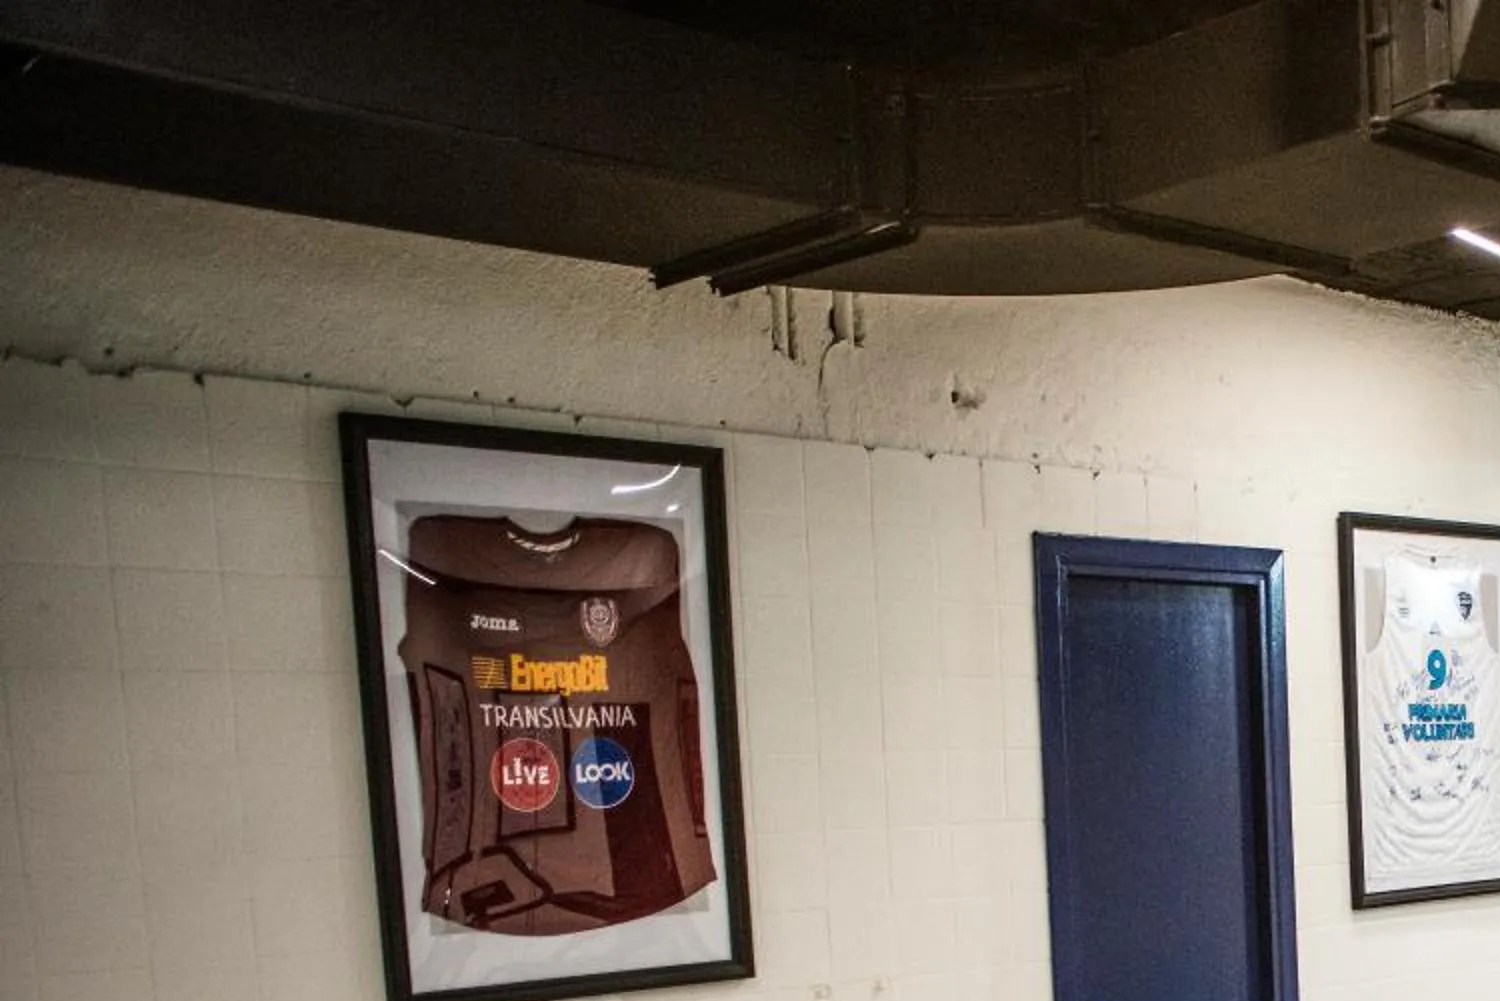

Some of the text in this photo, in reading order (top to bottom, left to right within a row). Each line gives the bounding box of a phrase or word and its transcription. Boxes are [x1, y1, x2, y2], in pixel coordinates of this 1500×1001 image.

[1427, 648, 1447, 691] 9
[479, 703, 637, 729] TRANSILVANIA
[575, 761, 632, 784] LOOK
